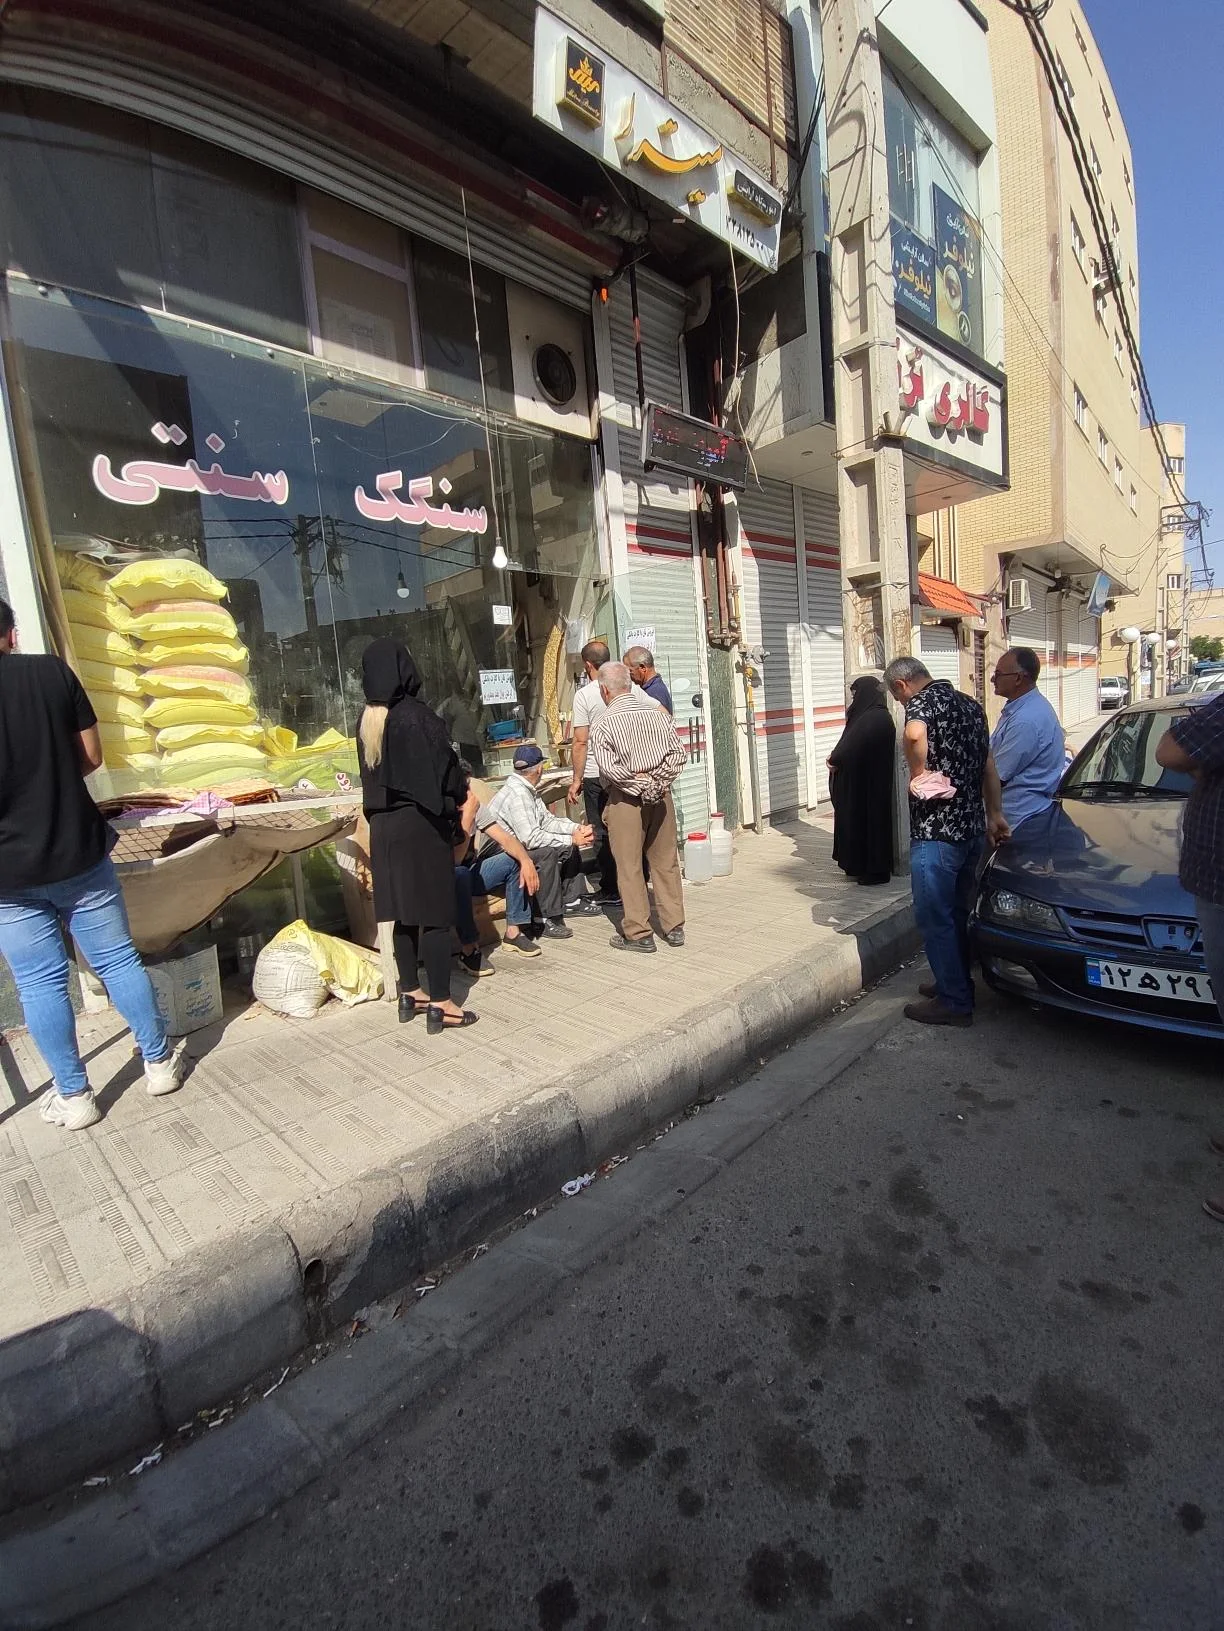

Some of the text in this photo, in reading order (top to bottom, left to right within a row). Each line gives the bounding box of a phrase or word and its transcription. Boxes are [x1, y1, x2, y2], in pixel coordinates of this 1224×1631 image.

[932, 381, 991, 432] گالری
[92, 421, 488, 534] سنگک سنتی
